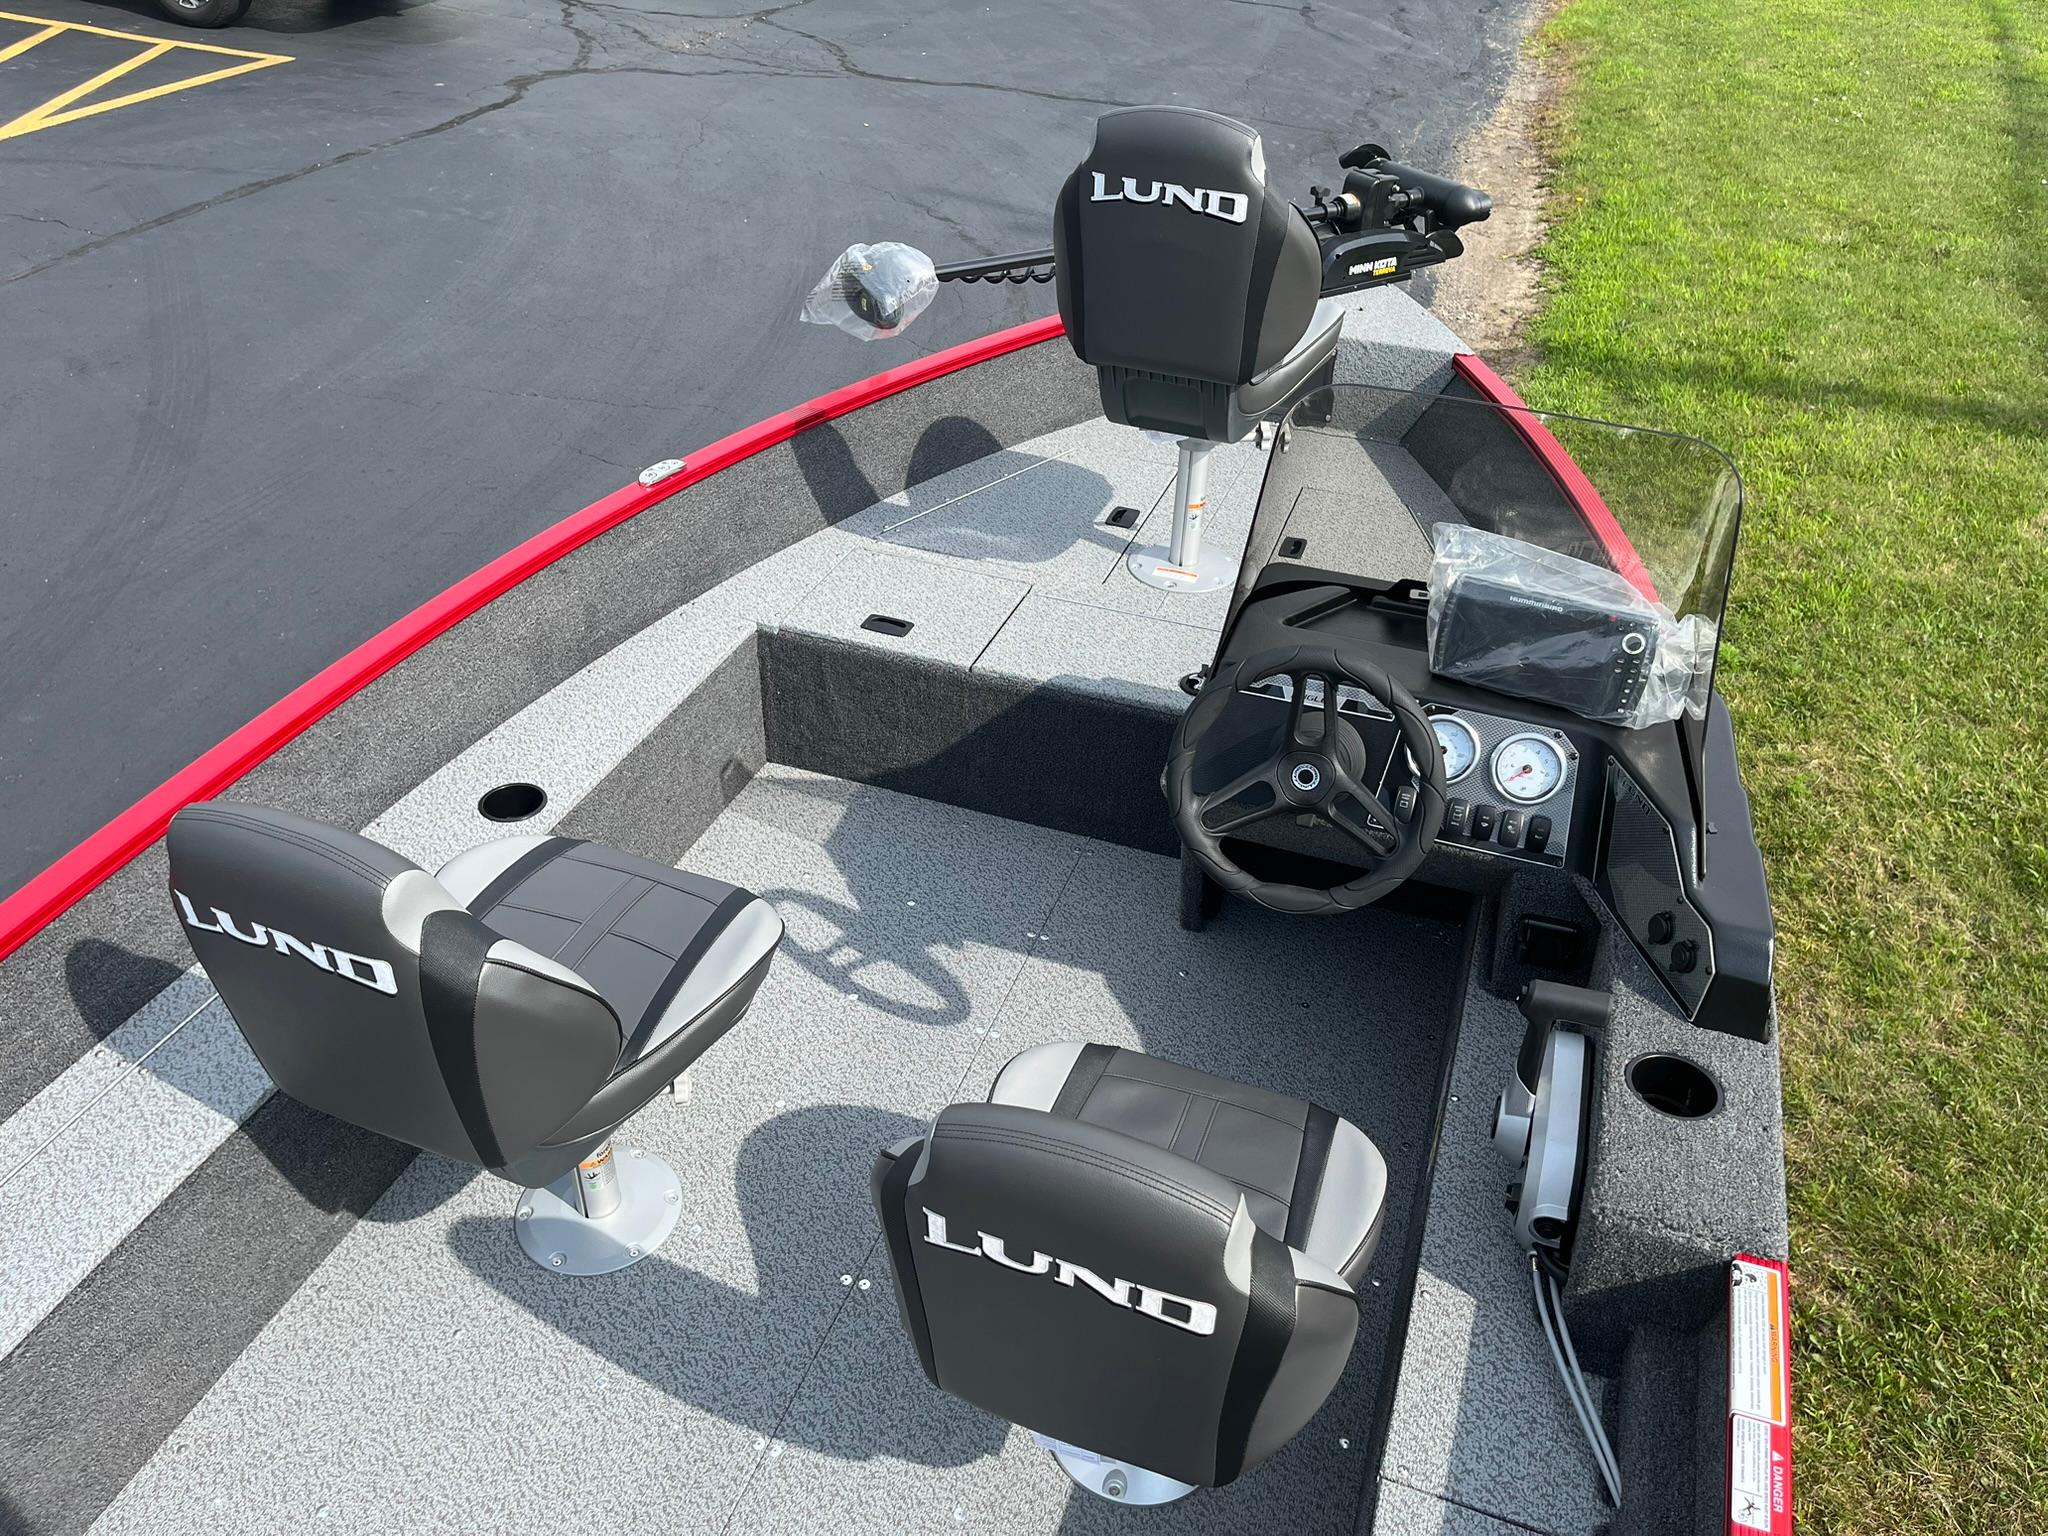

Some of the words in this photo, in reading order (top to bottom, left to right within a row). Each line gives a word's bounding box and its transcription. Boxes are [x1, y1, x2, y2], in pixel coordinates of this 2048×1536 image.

[1091, 172, 1248, 224] LUND
[1349, 262, 1373, 275] MINN
[1374, 257, 1397, 269] KOTA
[174, 888, 398, 995] LUND
[922, 1206, 1218, 1336] LUND
[1770, 1329, 1778, 1363] WARNING
[1772, 1465, 1784, 1513] DANGER
